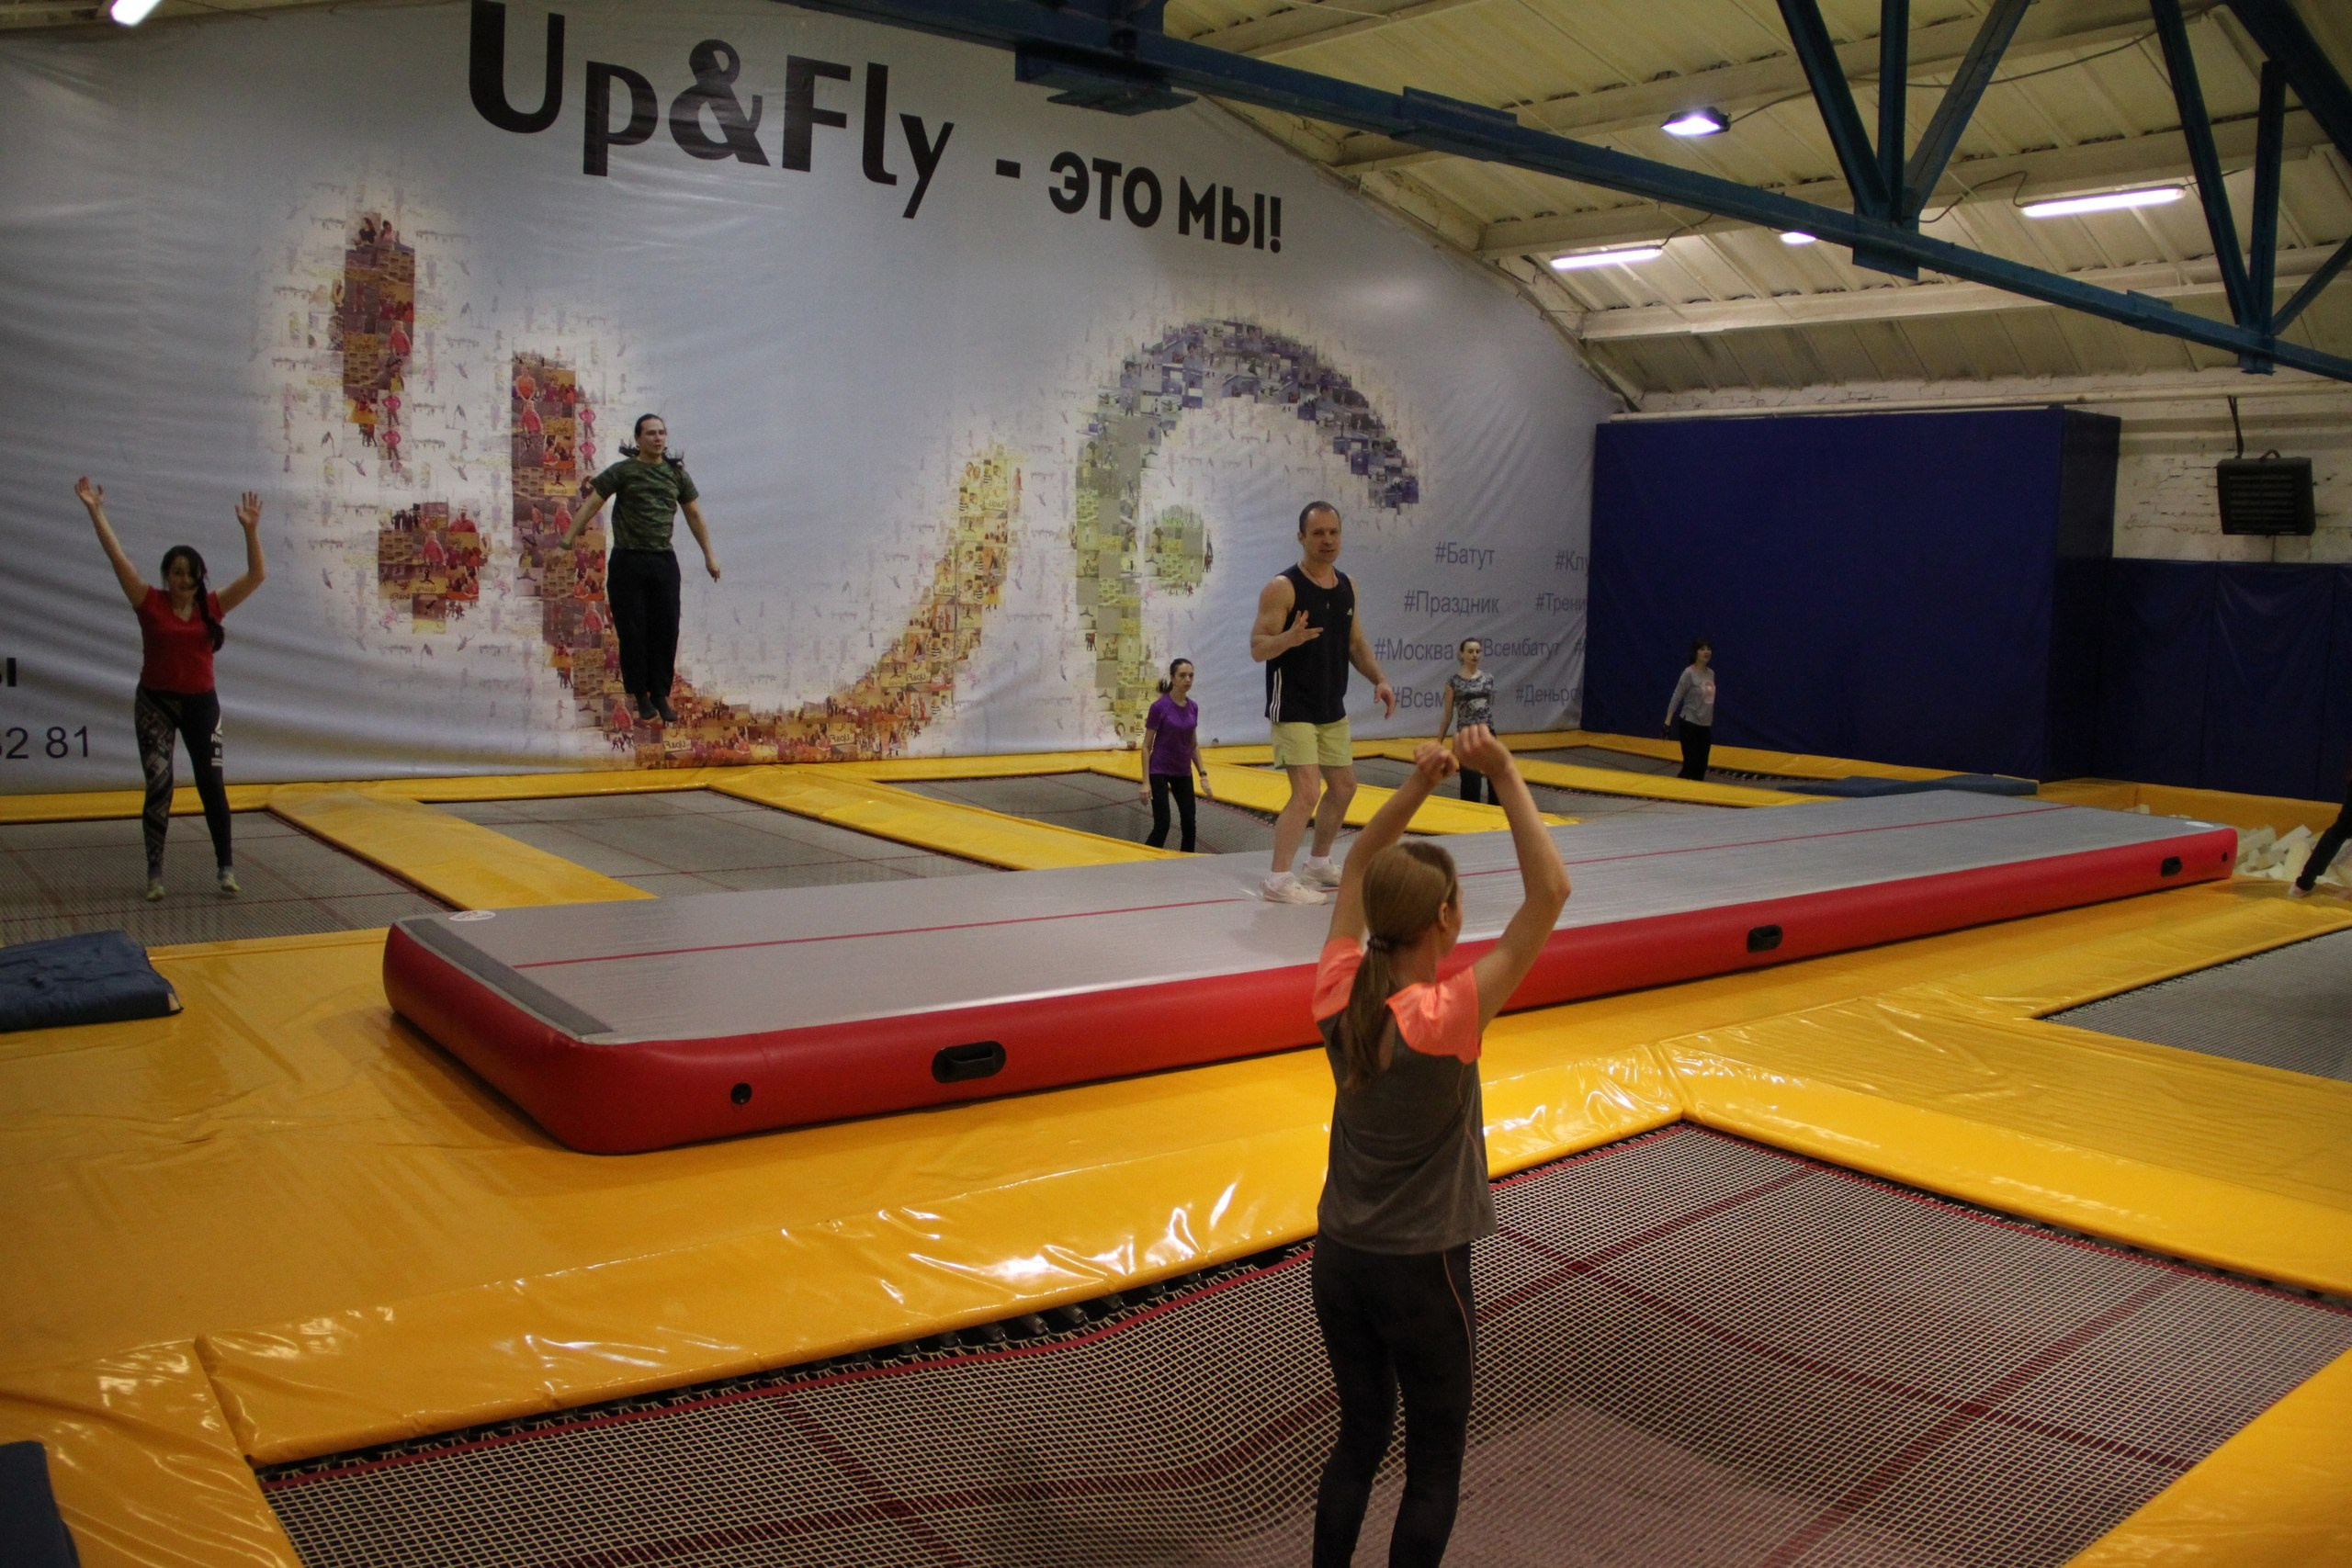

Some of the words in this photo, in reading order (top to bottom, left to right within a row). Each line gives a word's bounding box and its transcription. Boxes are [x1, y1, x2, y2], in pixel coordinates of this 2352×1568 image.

[469, 0, 955, 220] Up&Fly
[1435, 541, 1495, 570] #Батут
[1404, 590, 1499, 617] #Праздник
[1374, 637, 1453, 660] #Москва
[45, 726, 89, 759] 81
